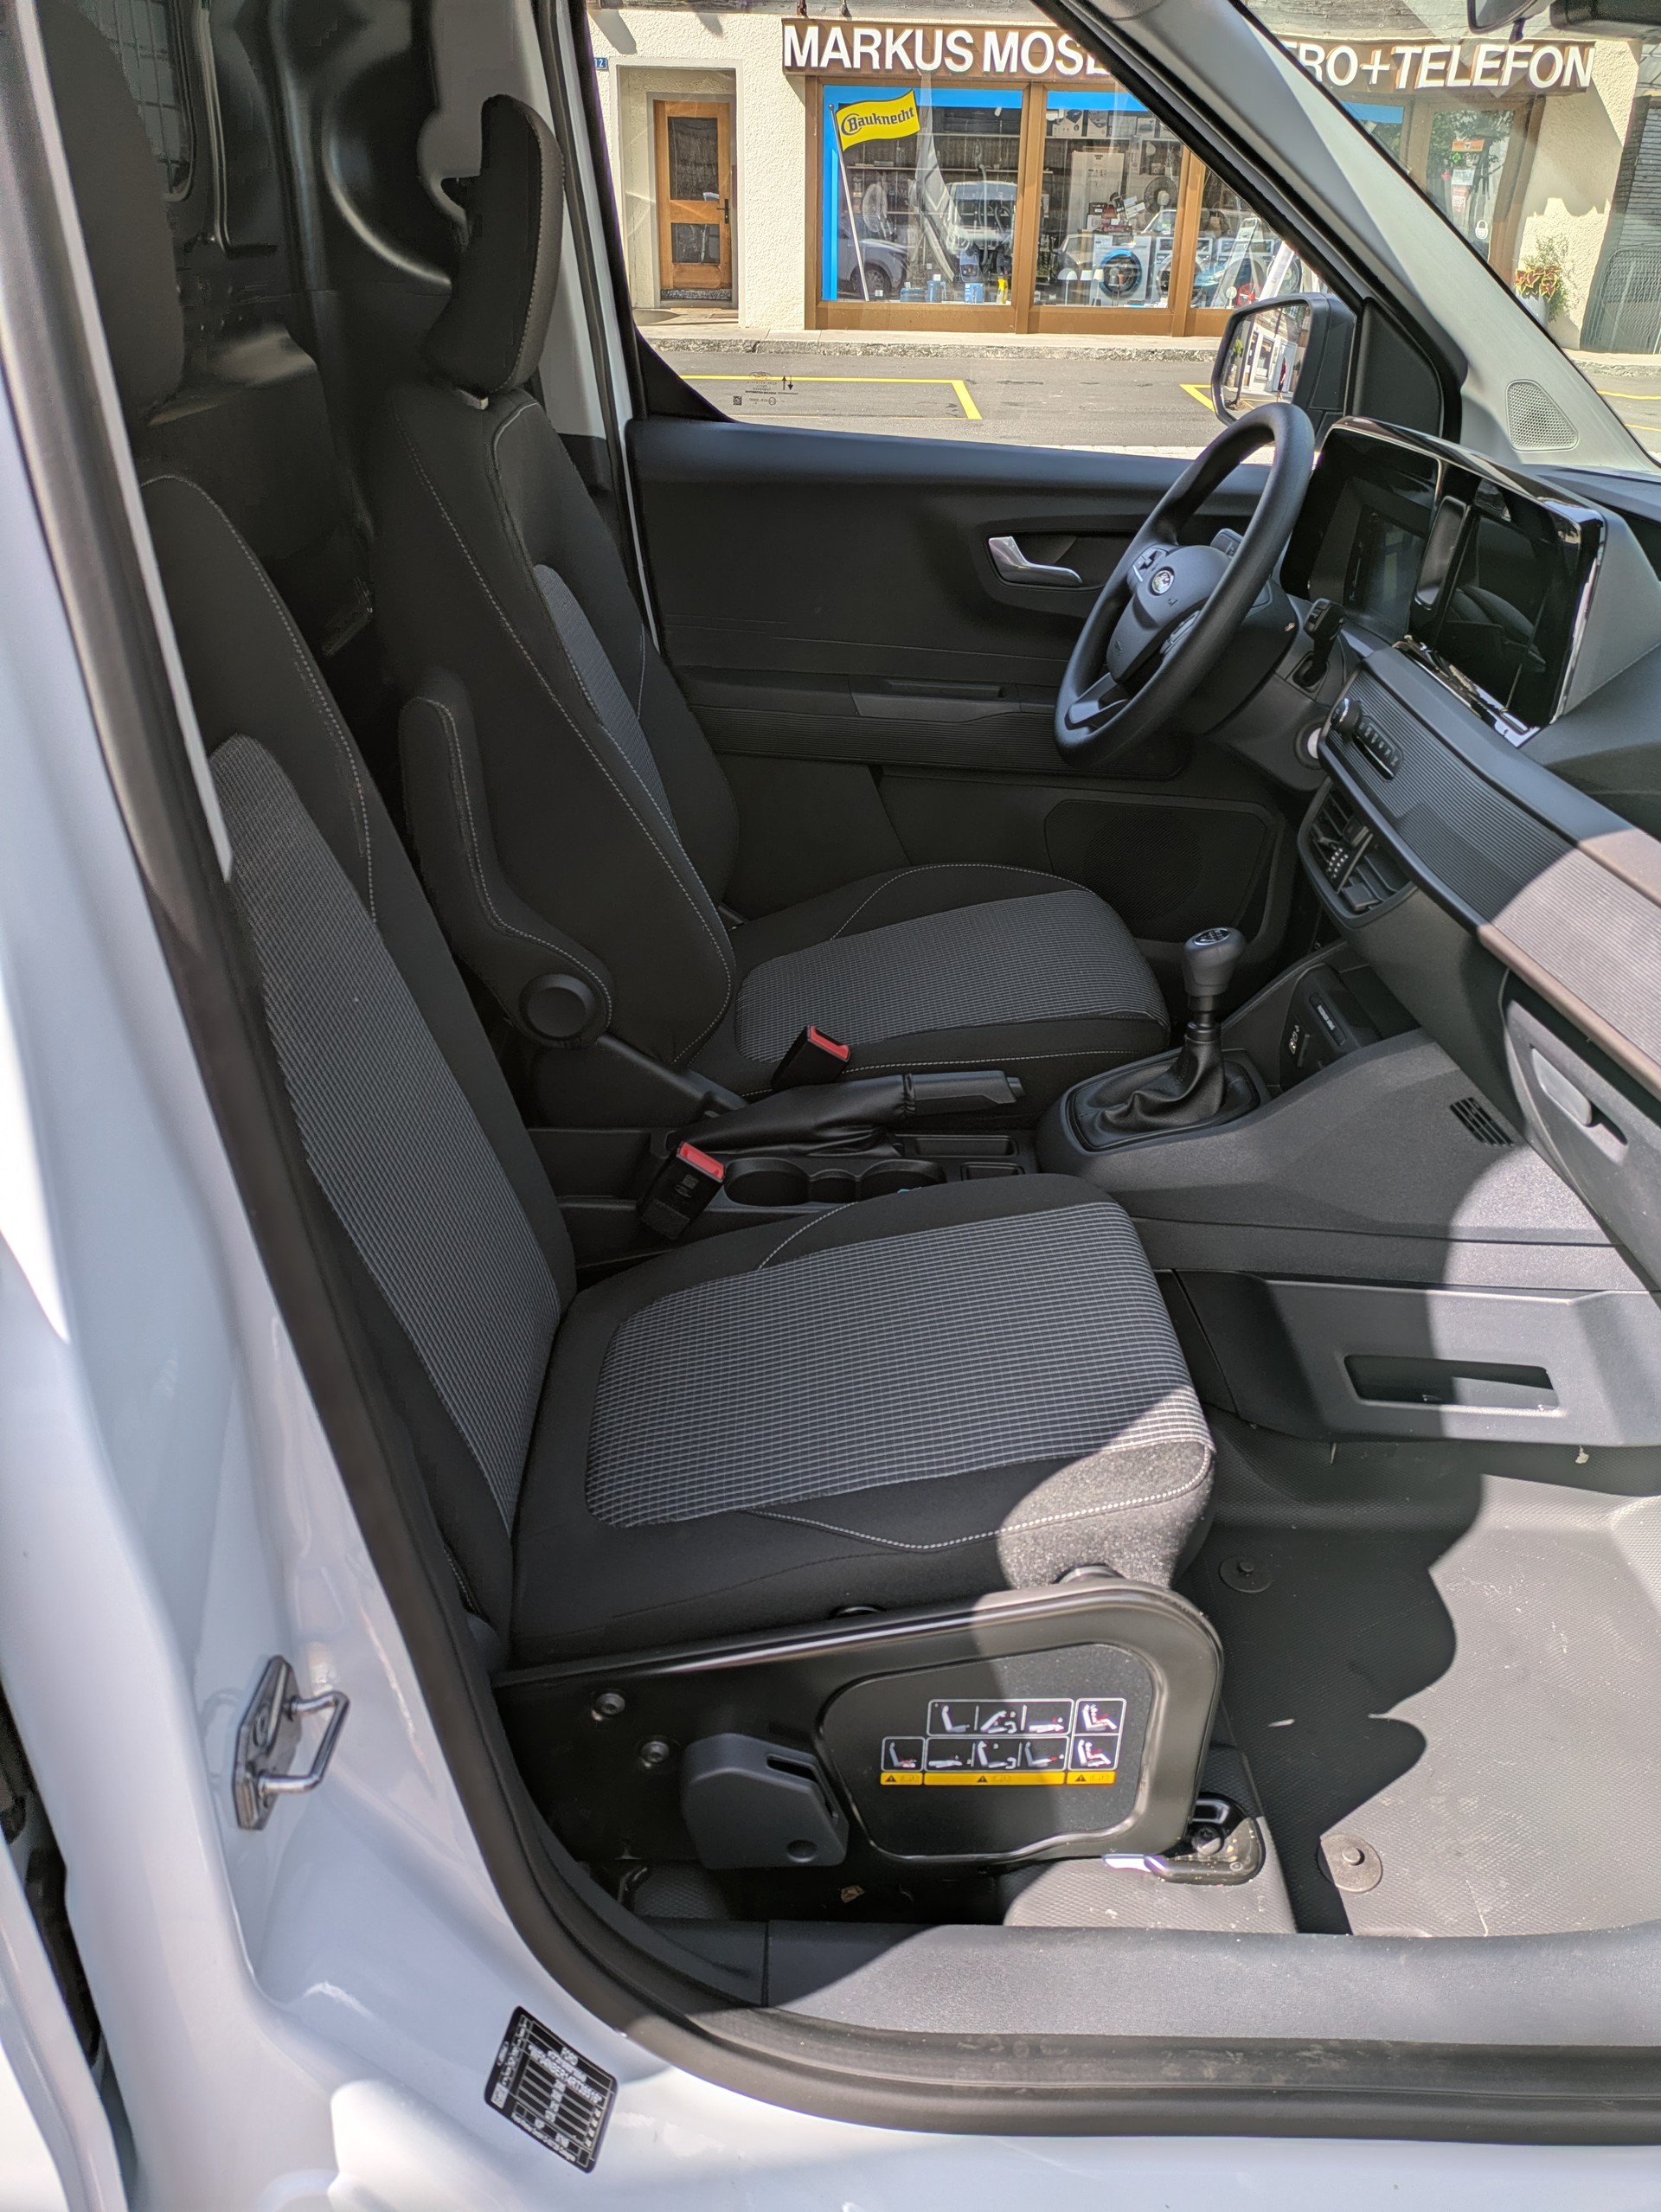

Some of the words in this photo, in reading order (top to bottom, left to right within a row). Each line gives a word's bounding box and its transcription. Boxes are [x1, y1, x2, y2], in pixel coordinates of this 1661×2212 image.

[784, 24, 974, 72] MARKUS
[1279, 42, 1595, 89] RO+TELEFON
[841, 106, 914, 136] Bauknecht
